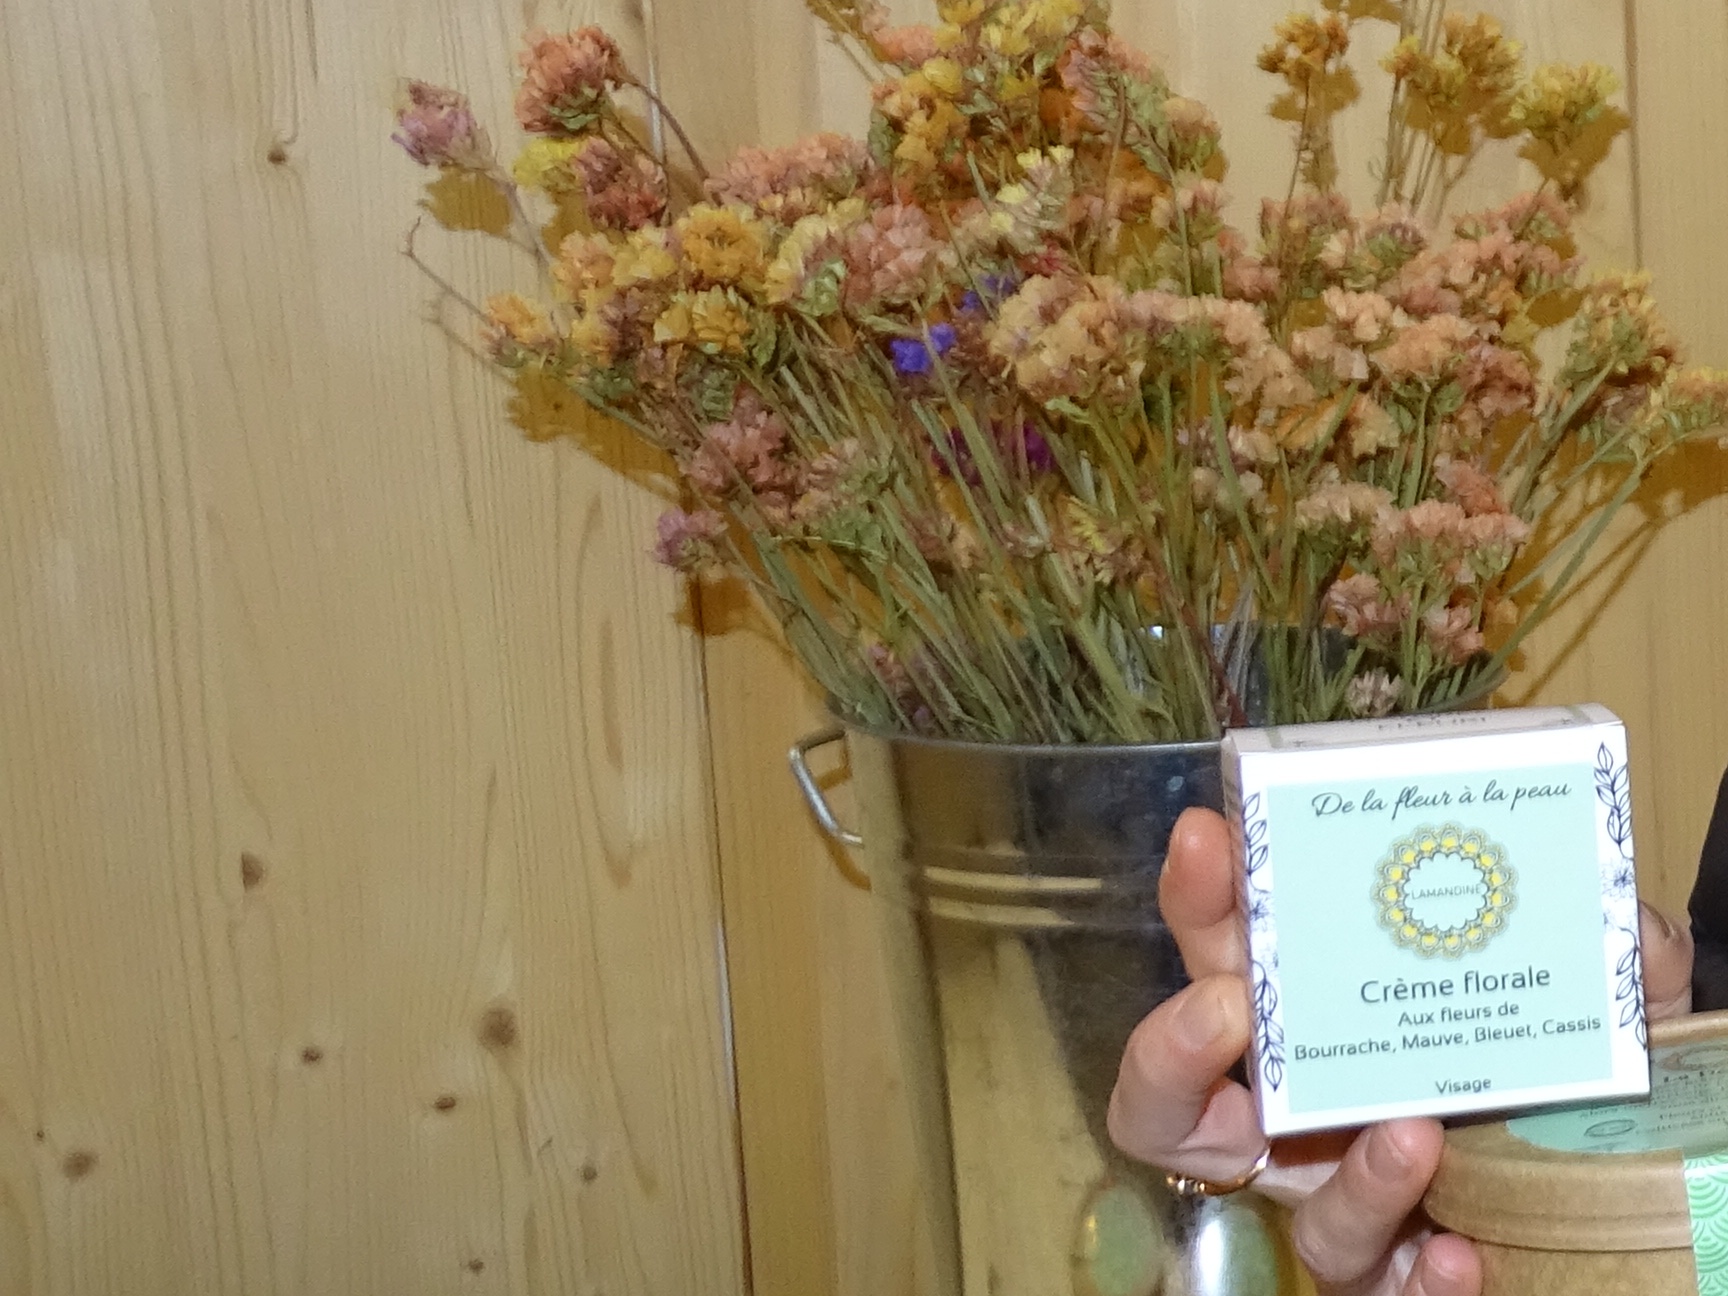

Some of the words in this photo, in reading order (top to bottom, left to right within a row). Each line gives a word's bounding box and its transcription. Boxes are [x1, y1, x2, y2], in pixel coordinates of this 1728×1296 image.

[1311, 791, 1355, 817] De
[1361, 789, 1387, 813] la
[1391, 785, 1453, 820] fleur
[1459, 784, 1476, 804] à
[1482, 780, 1509, 803] la
[1510, 782, 1571, 811] peau
[1410, 883, 1483, 901] LAMANDINE
[1360, 974, 1454, 1004] Crème
[1464, 965, 1551, 996] florale
[1398, 1010, 1435, 1027] Aux
[1440, 1004, 1493, 1023] fleurs
[1497, 1001, 1520, 1018] de
[1294, 1036, 1397, 1061] Bourrache,
[1402, 1030, 1470, 1052] Mauve,
[1474, 1023, 1538, 1044] Bleuet,
[1542, 1015, 1602, 1036] Cassis
[1435, 1075, 1492, 1095] Visage
